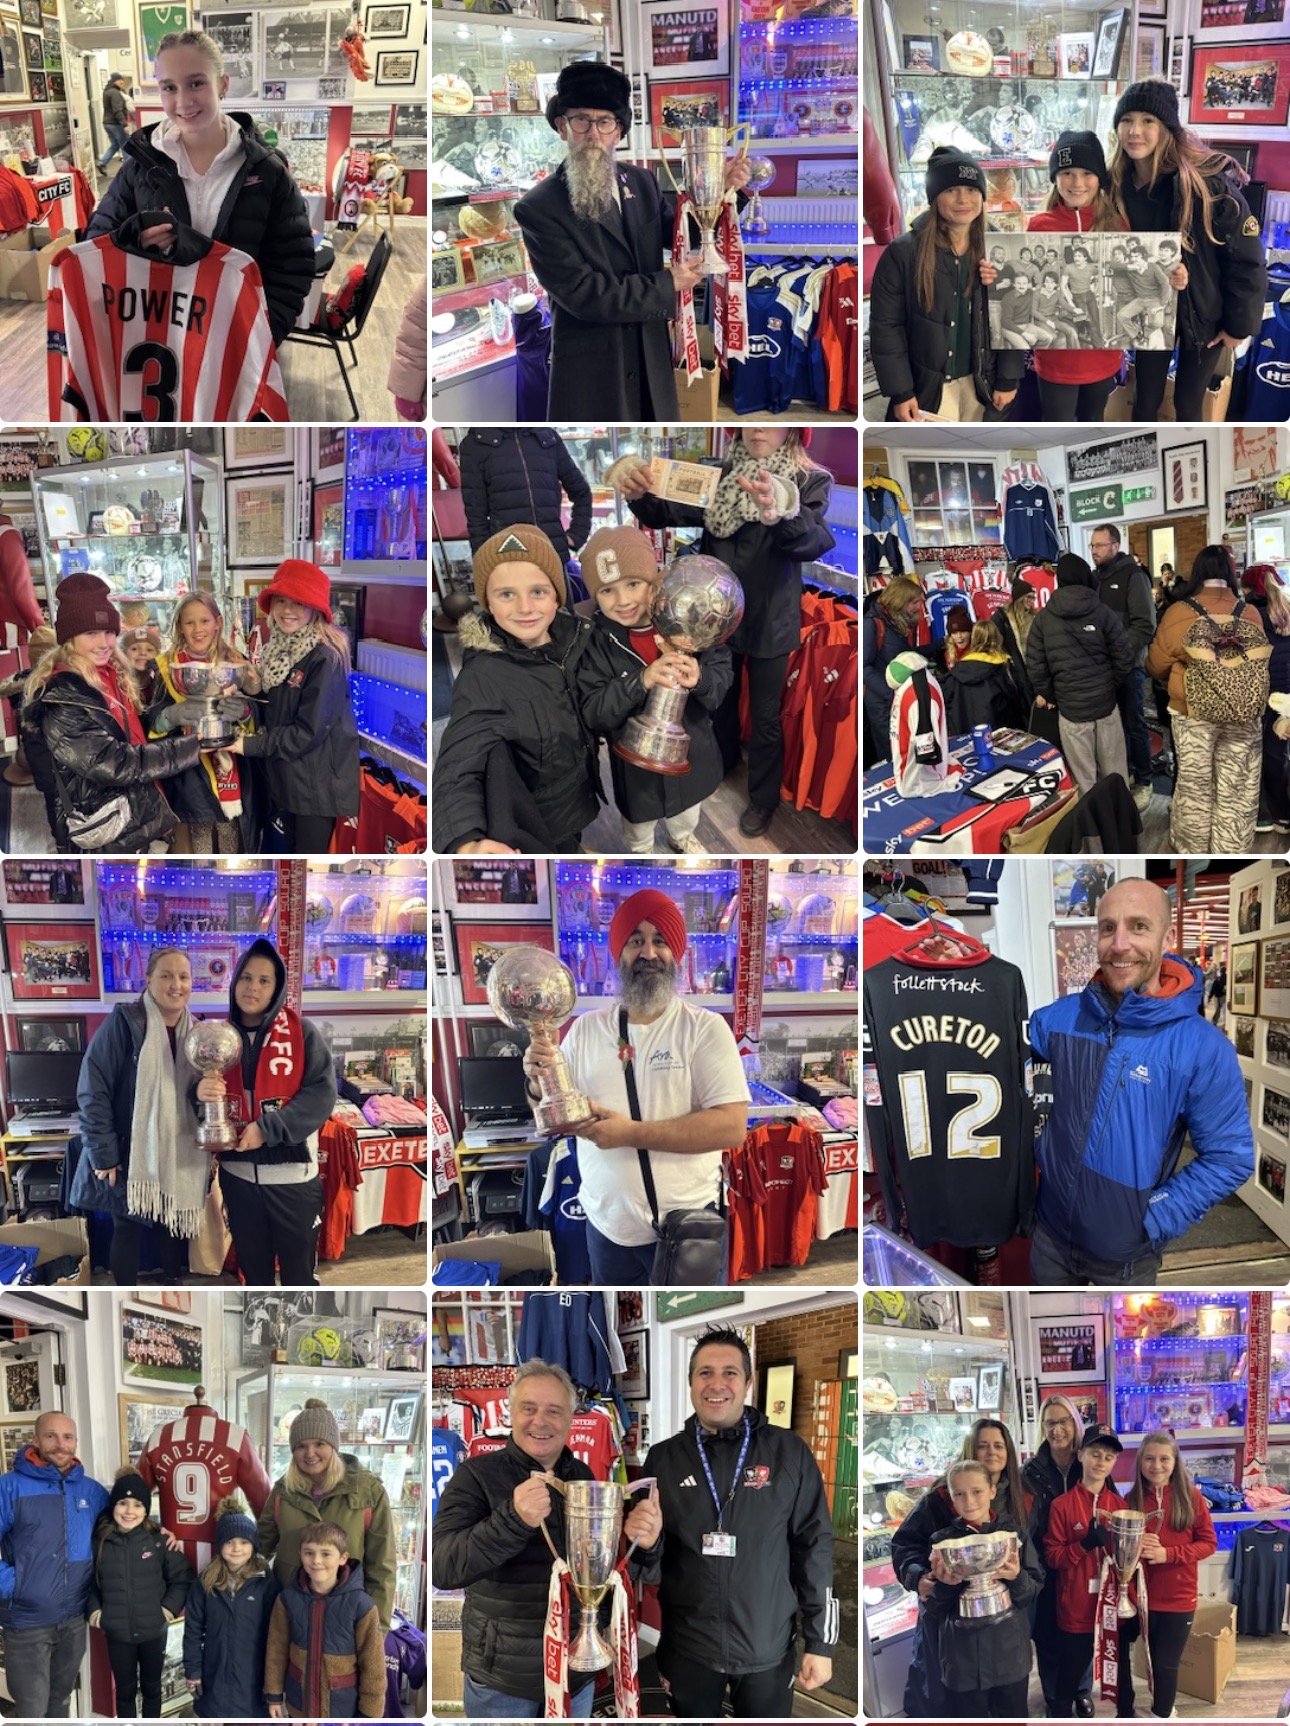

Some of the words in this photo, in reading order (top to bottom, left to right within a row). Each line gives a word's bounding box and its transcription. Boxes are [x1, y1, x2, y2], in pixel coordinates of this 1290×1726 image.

[652, 10, 717, 26] MANUTD
[38, 185, 58, 202] CITY
[58, 181, 71, 195] FC
[101, 282, 208, 335] POWER
[728, 294, 740, 321] sky
[686, 316, 695, 340] sky
[728, 322, 743, 351] bet
[687, 341, 699, 372] bet
[123, 339, 181, 422] 3
[1103, 490, 1117, 511] C
[890, 1015, 1001, 1059] CURETON
[898, 1070, 1002, 1160] 12
[156, 1442, 233, 1485] STANSFIELD
[173, 1462, 210, 1525] 9
[547, 1642, 560, 1677] bet
[1104, 1638, 1117, 1661] sky
